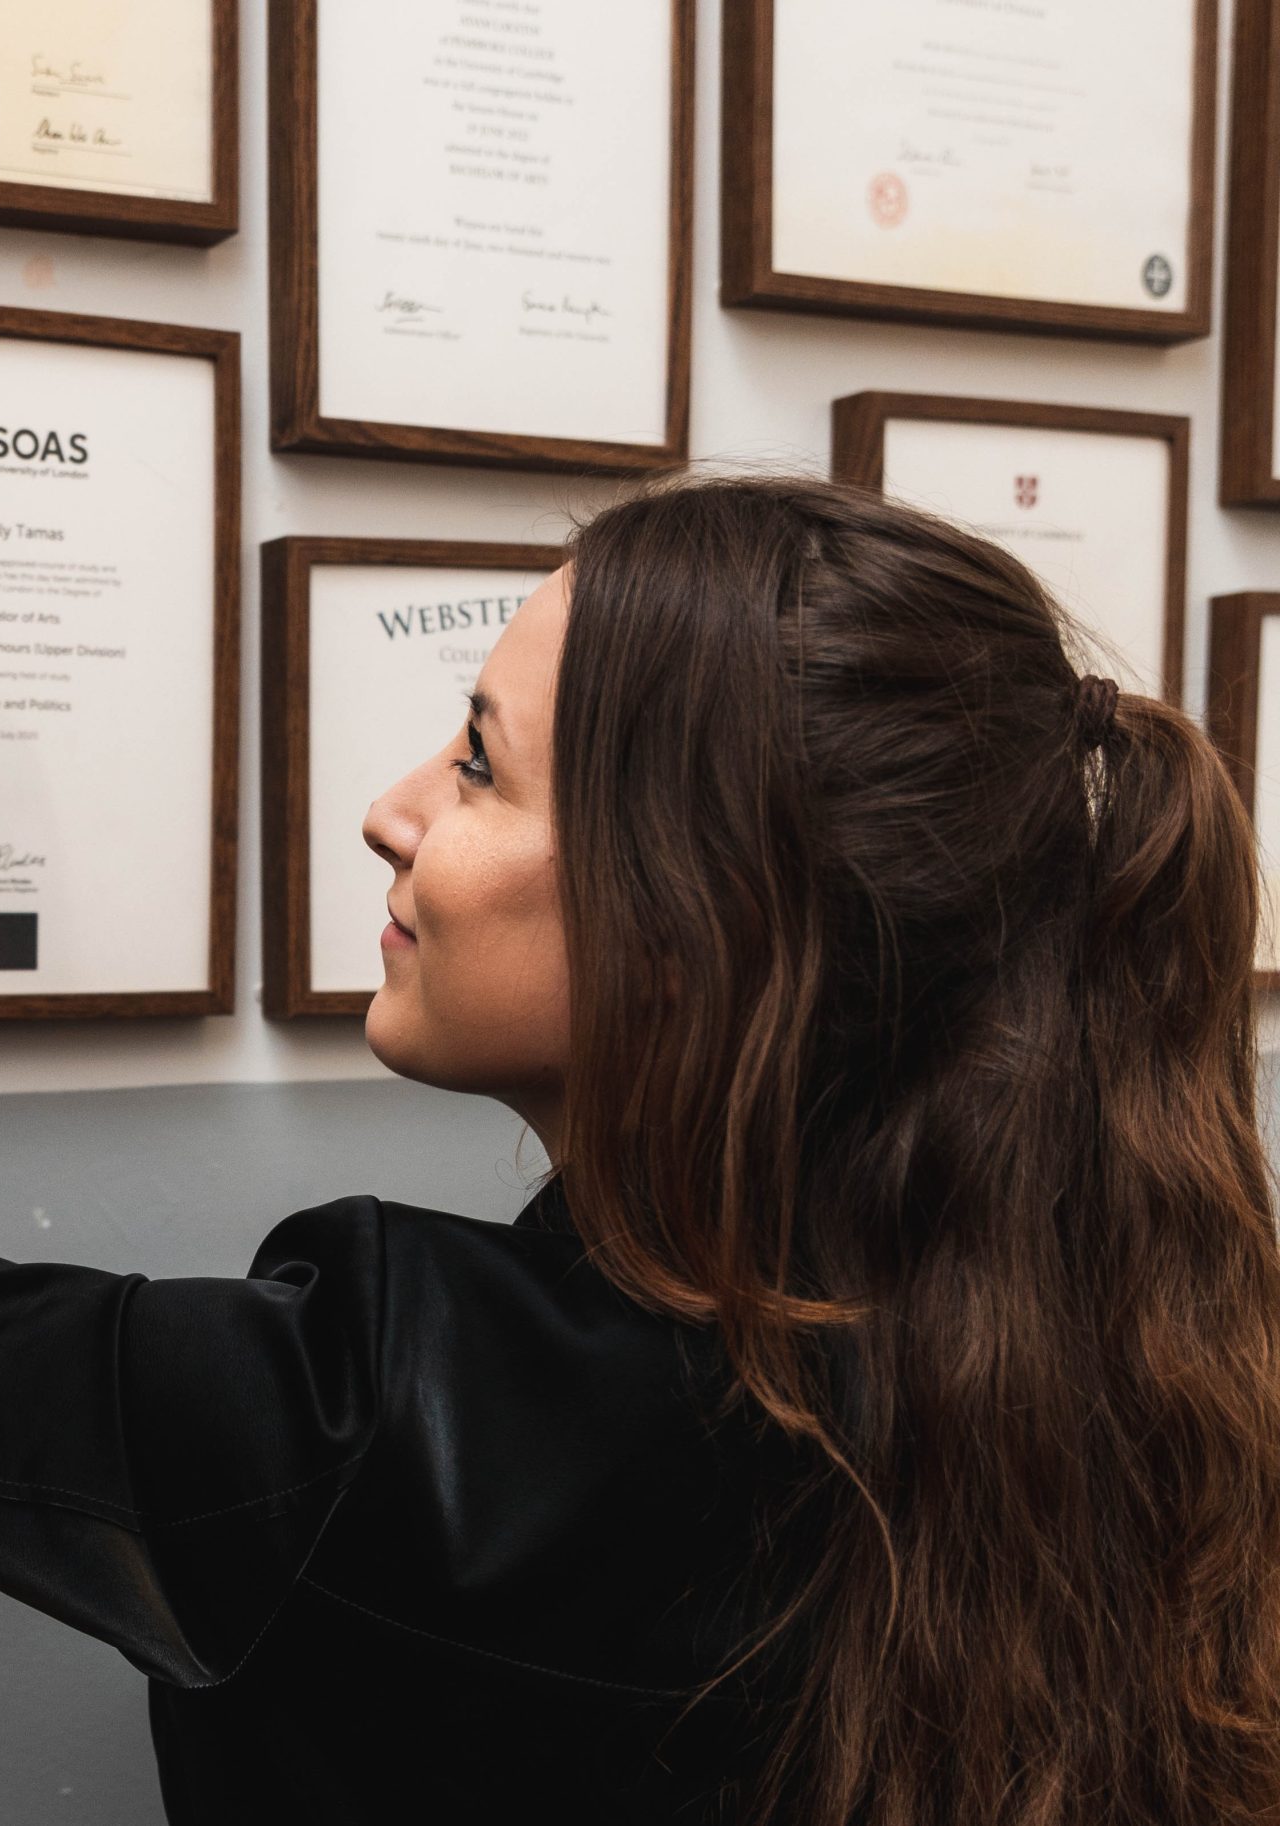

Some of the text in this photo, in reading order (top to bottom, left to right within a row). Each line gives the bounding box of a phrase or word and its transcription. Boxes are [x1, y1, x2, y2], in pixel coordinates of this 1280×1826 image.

[39, 467, 50, 477] of
[52, 469, 89, 479] London
[16, 523, 65, 541] Tamas
[21, 611, 35, 623] of
[37, 612, 61, 624] Arts
[377, 596, 528, 640] WEBSTE
[3, 698, 26, 710] and
[29, 699, 71, 712] Politics
